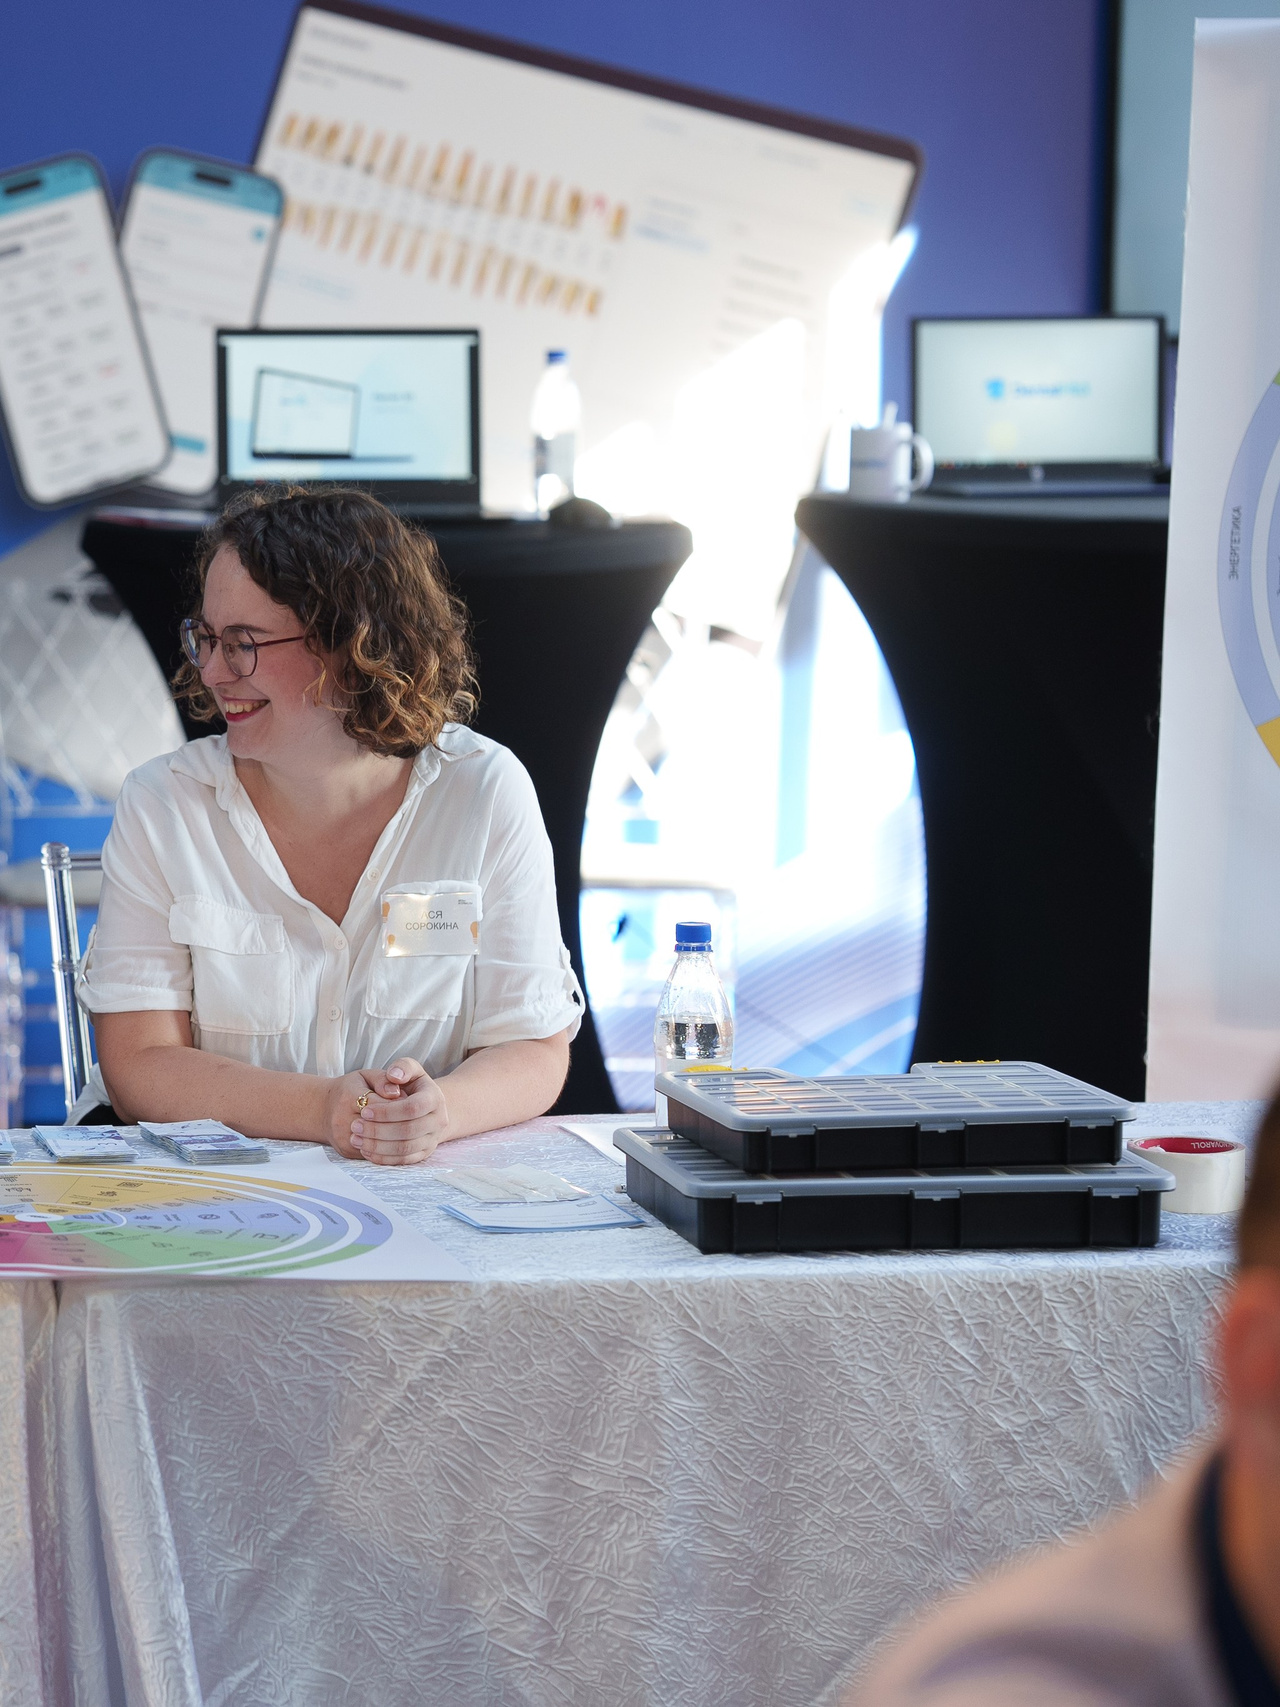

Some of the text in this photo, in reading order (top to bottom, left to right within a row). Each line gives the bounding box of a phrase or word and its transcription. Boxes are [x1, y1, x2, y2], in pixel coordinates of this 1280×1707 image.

[1228, 505, 1241, 580] ЭНЕРГЕТИКА
[421, 910, 443, 920] АСЯ
[405, 922, 459, 931] СОРОКИНА
